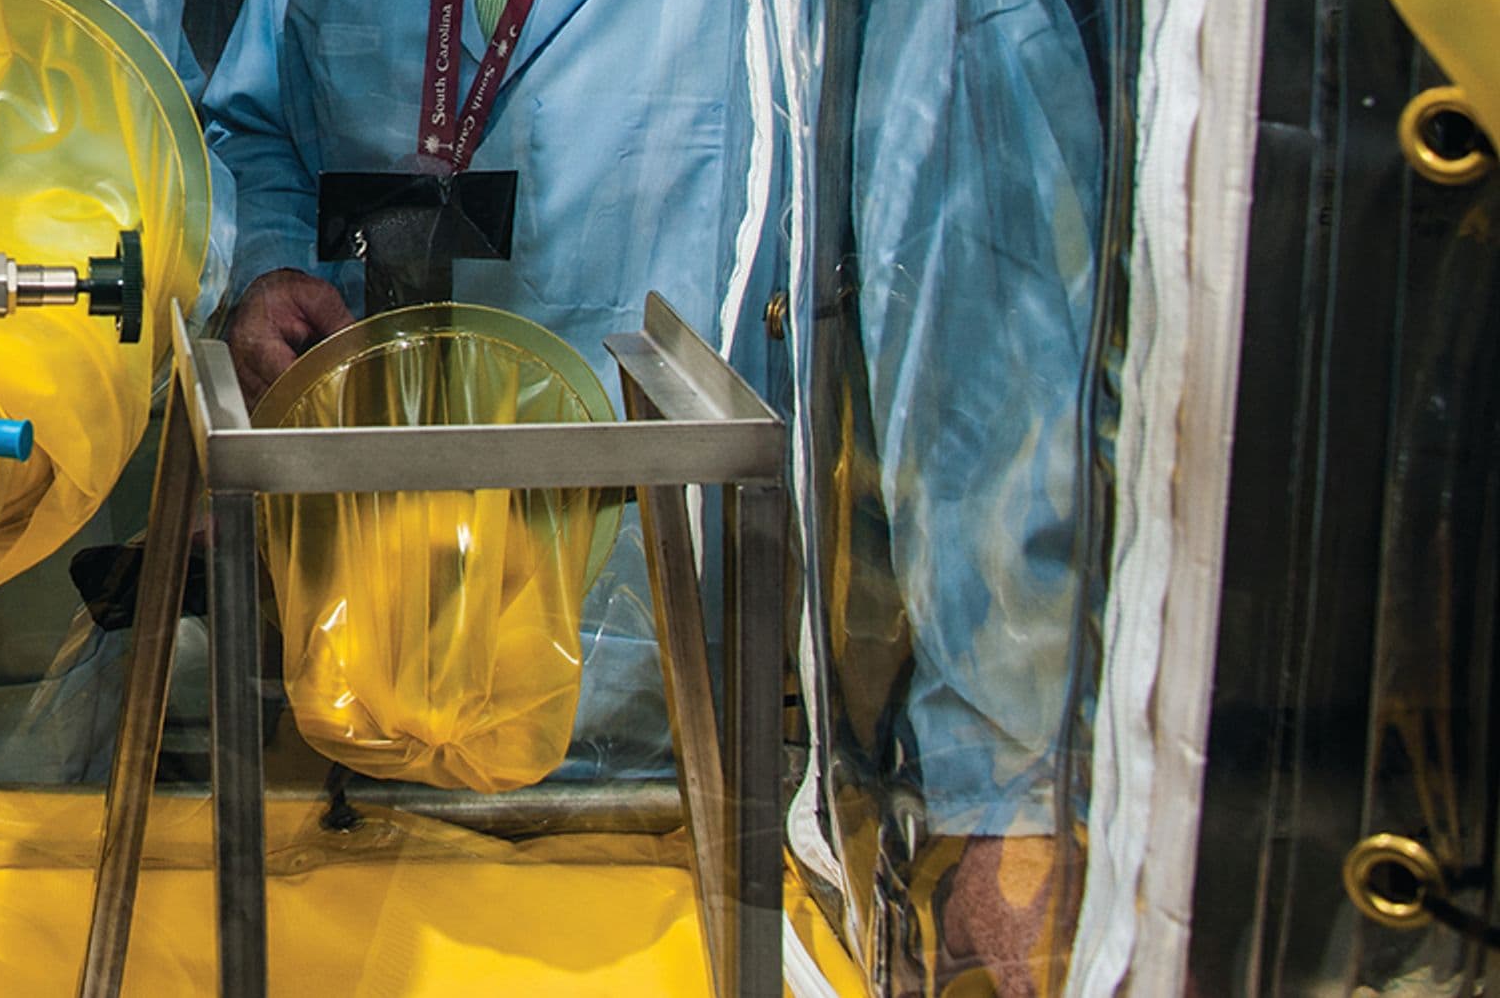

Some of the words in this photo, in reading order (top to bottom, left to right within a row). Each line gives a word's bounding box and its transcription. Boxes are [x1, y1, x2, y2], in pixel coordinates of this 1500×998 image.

[435, 3, 453, 73] Carolina
[431, 77, 447, 127] South
[471, 63, 496, 110] South
